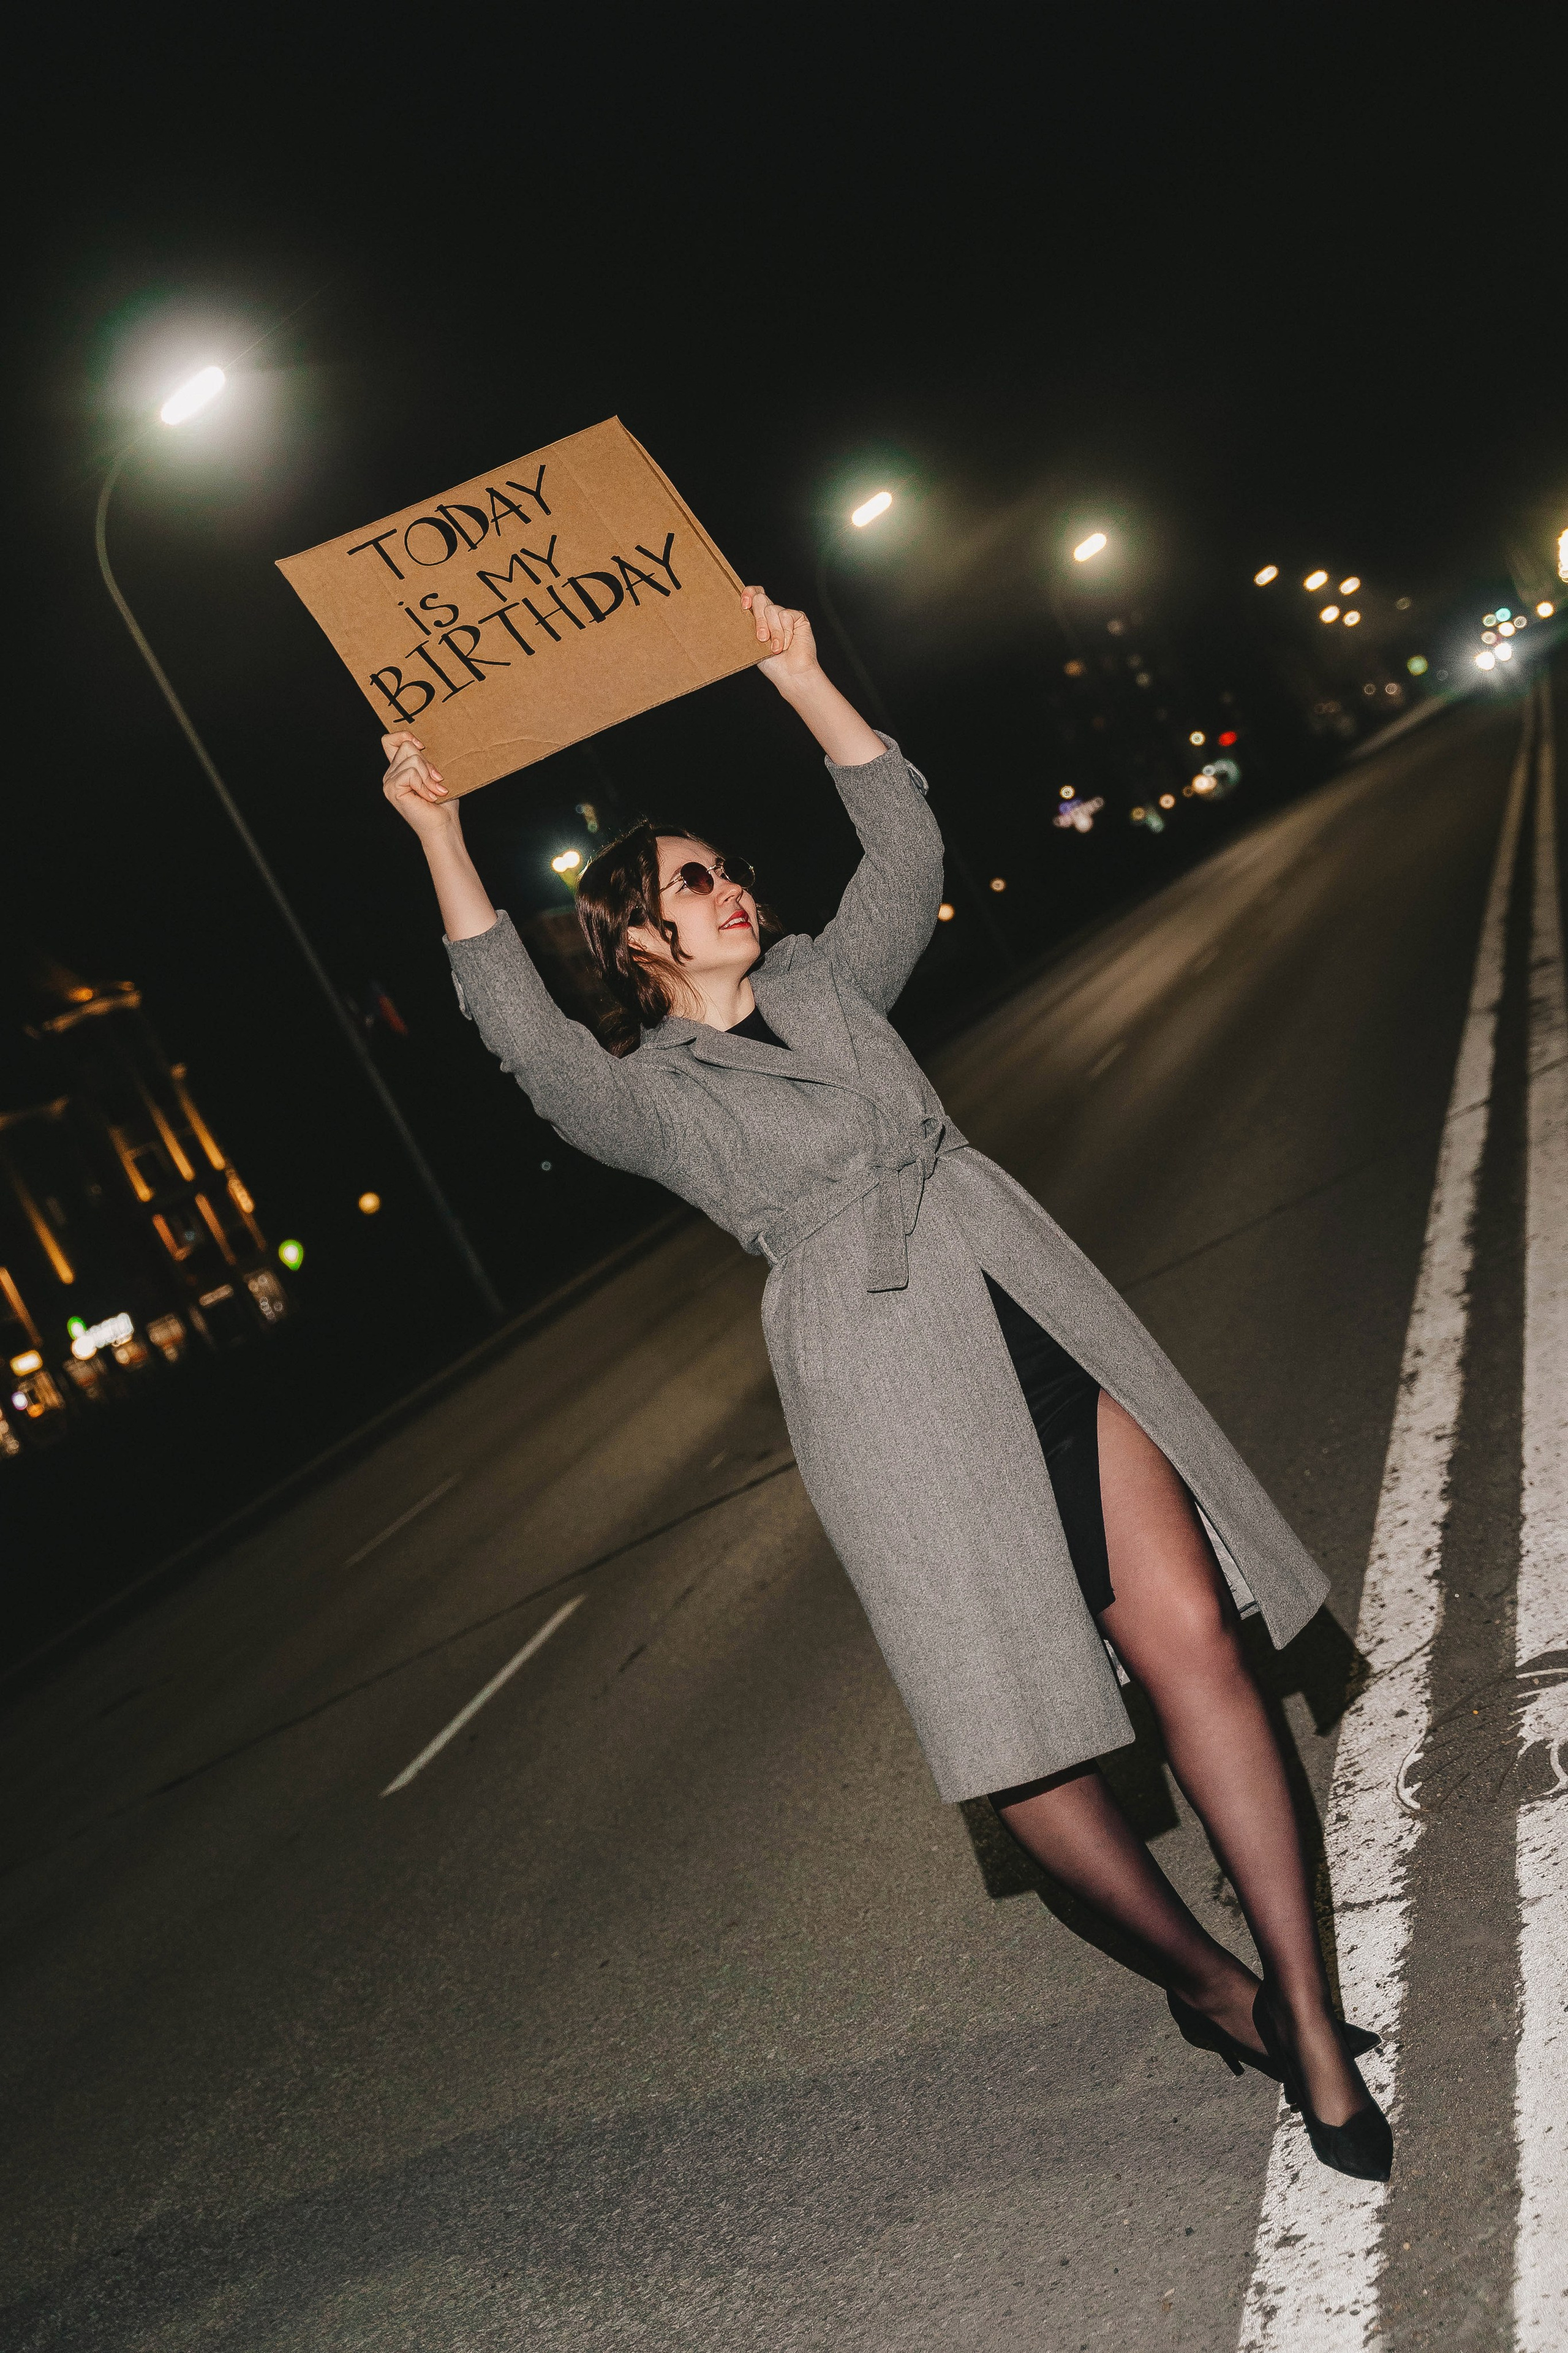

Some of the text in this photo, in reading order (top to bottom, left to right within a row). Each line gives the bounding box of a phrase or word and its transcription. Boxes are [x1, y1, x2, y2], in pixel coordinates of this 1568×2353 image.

[347, 464, 552, 580] TODAY
[476, 534, 561, 603] MY
[369, 532, 682, 724] BIRTHDAY
